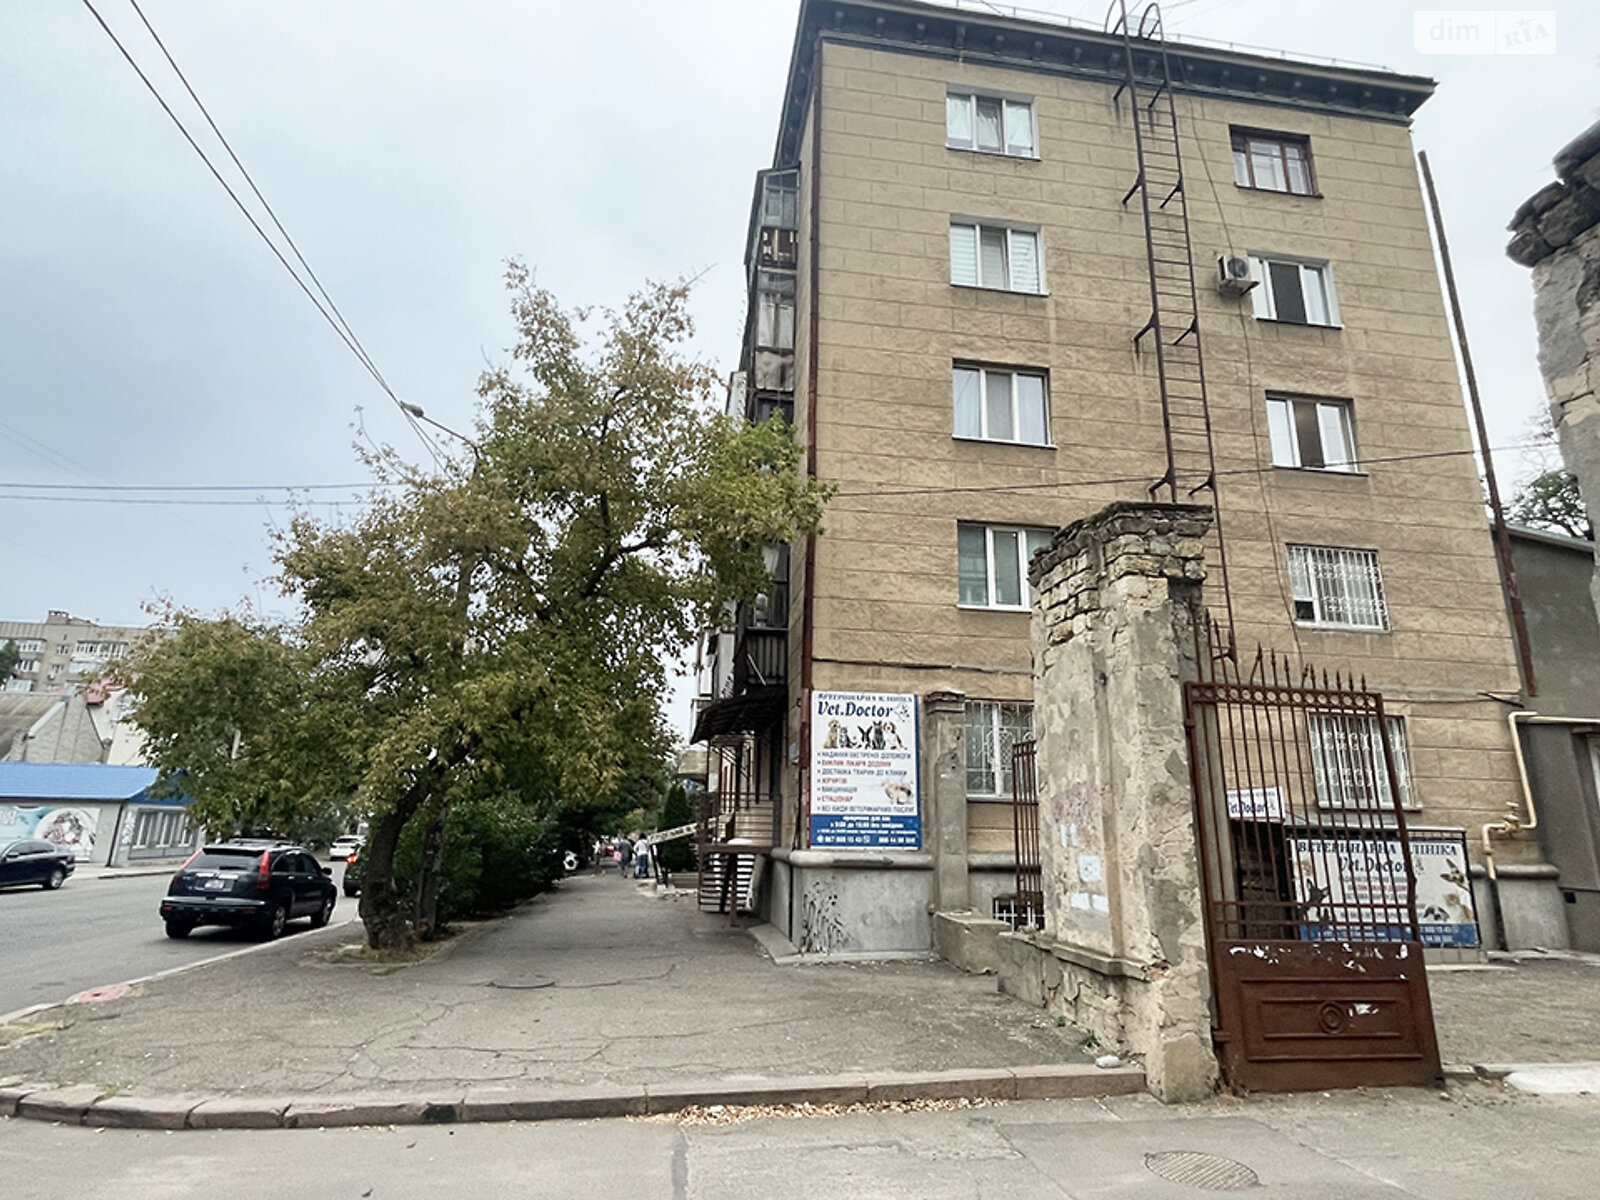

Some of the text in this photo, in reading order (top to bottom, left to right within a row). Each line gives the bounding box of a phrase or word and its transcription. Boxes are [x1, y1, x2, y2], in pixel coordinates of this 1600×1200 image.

[818, 701, 893, 717] Vet.Doctor
[1298, 841, 1457, 856] ВТЕРИНРНА ЛІНІКА
[1339, 857, 1407, 873] Vt.Dco
